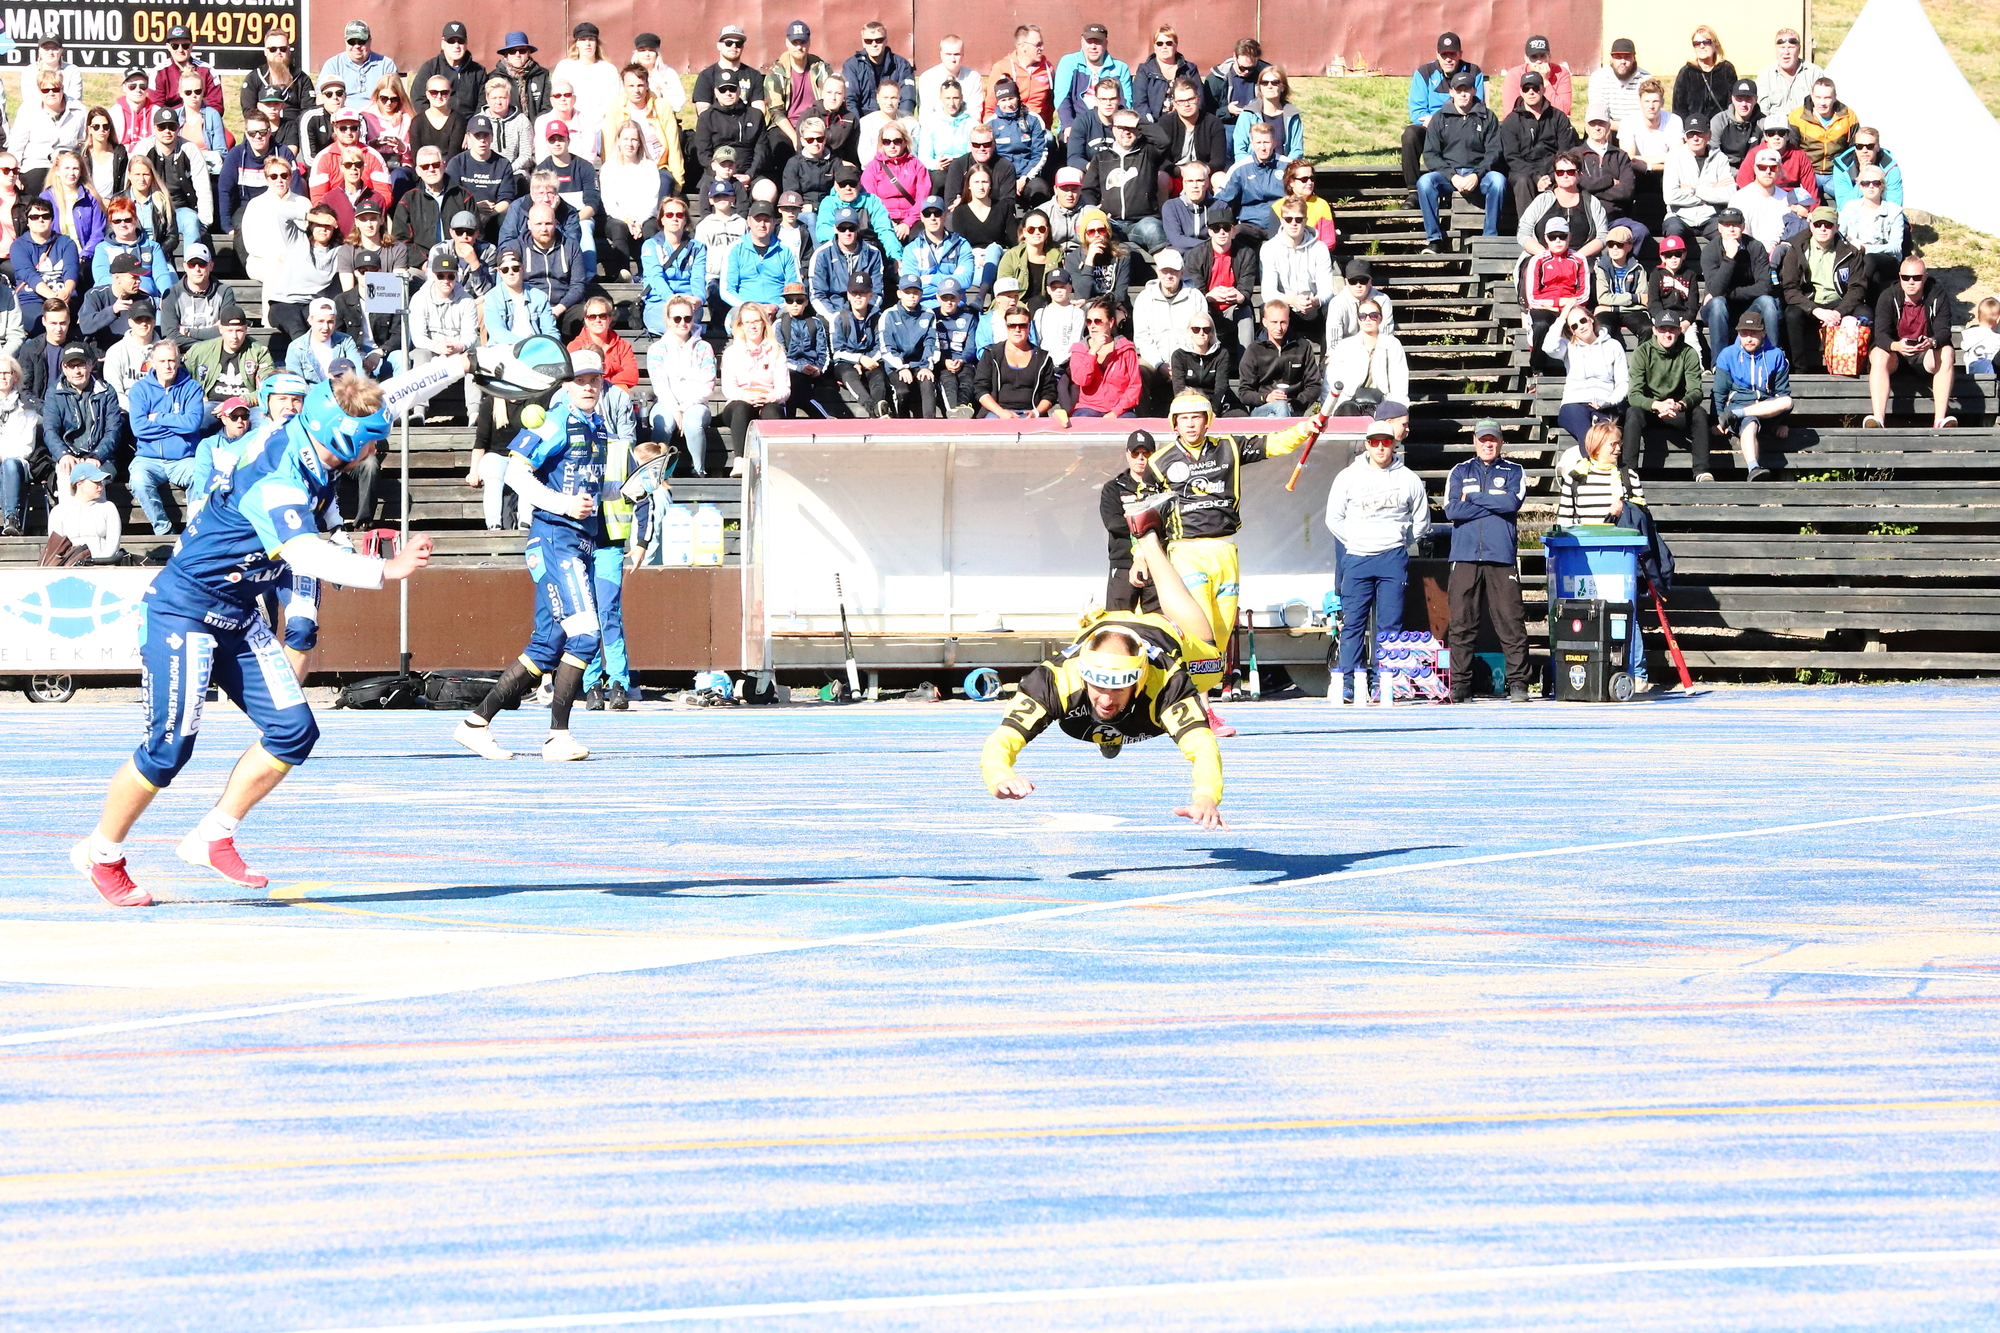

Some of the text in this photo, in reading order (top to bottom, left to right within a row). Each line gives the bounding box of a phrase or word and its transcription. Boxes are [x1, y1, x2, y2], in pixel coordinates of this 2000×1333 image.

[4, 8, 123, 41] MARTIMO
[1189, 459, 1217, 471] RAAHEN
[284, 508, 303, 530] 9
[1565, 654, 1589, 662] STANLEY
[1011, 698, 1038, 723] 2
[1171, 700, 1197, 727] 2
